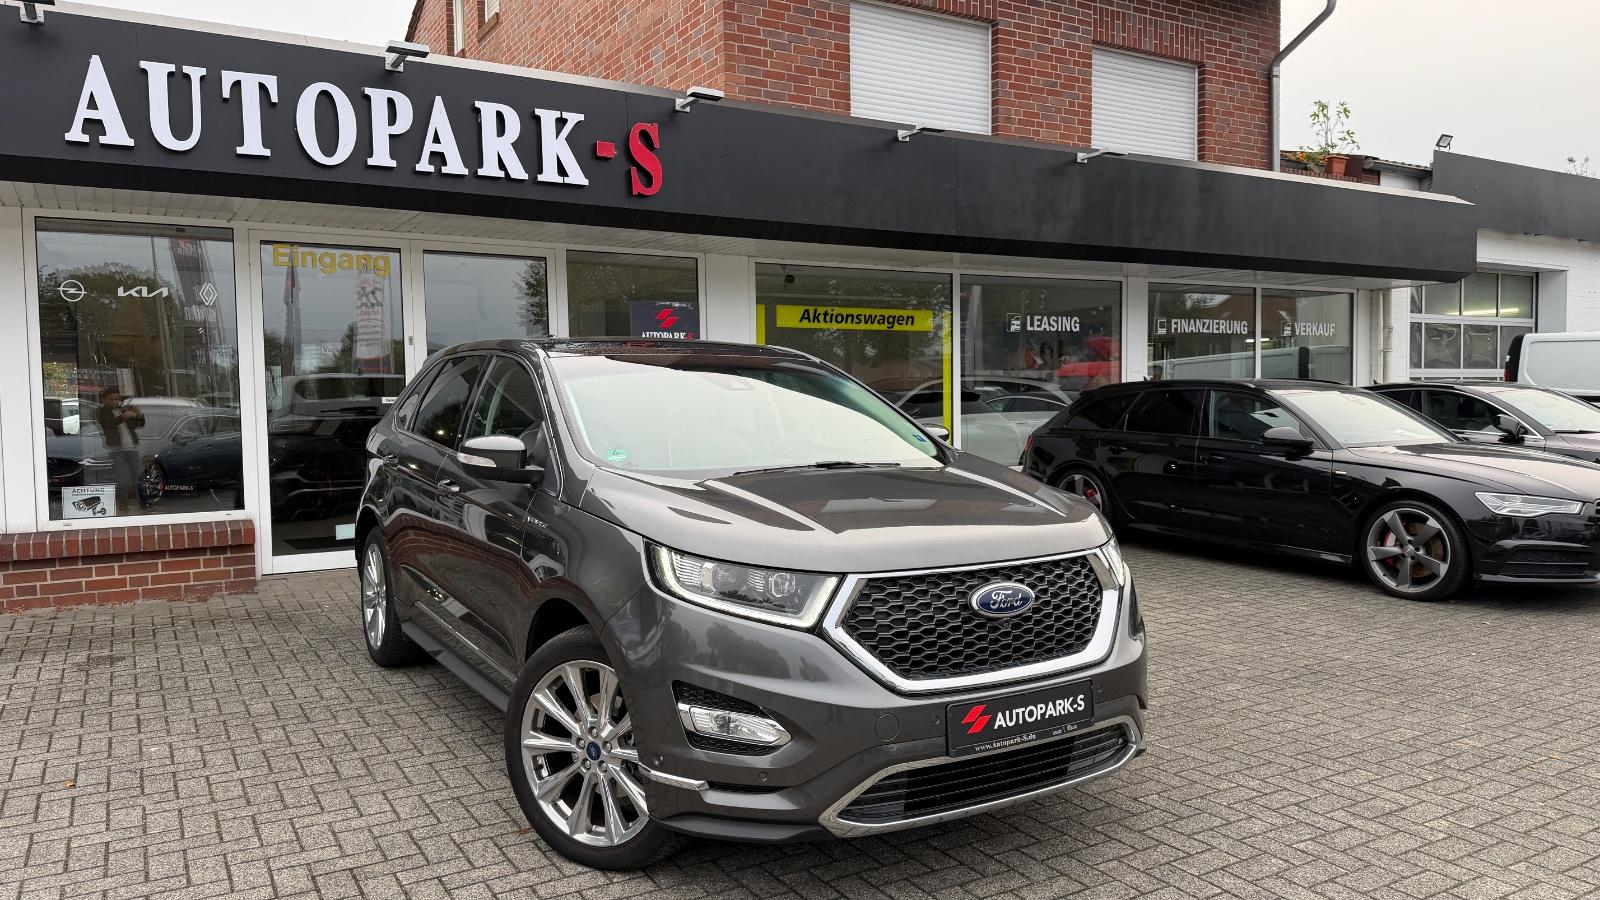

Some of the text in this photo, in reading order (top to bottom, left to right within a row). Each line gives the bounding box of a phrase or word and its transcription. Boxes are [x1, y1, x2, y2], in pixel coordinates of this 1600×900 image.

[64, 54, 663, 197] AUTOPARK-S
[272, 243, 390, 278] Eingang
[117, 285, 169, 298] KIA
[799, 308, 915, 329] Aktionswagen
[1026, 314, 1080, 332] LEASING
[1171, 318, 1249, 335] FINANZIERUNG
[1294, 322, 1336, 337] VERKAUF
[989, 589, 1023, 610] Ford
[993, 694, 1085, 730] AUTOPARK-S
